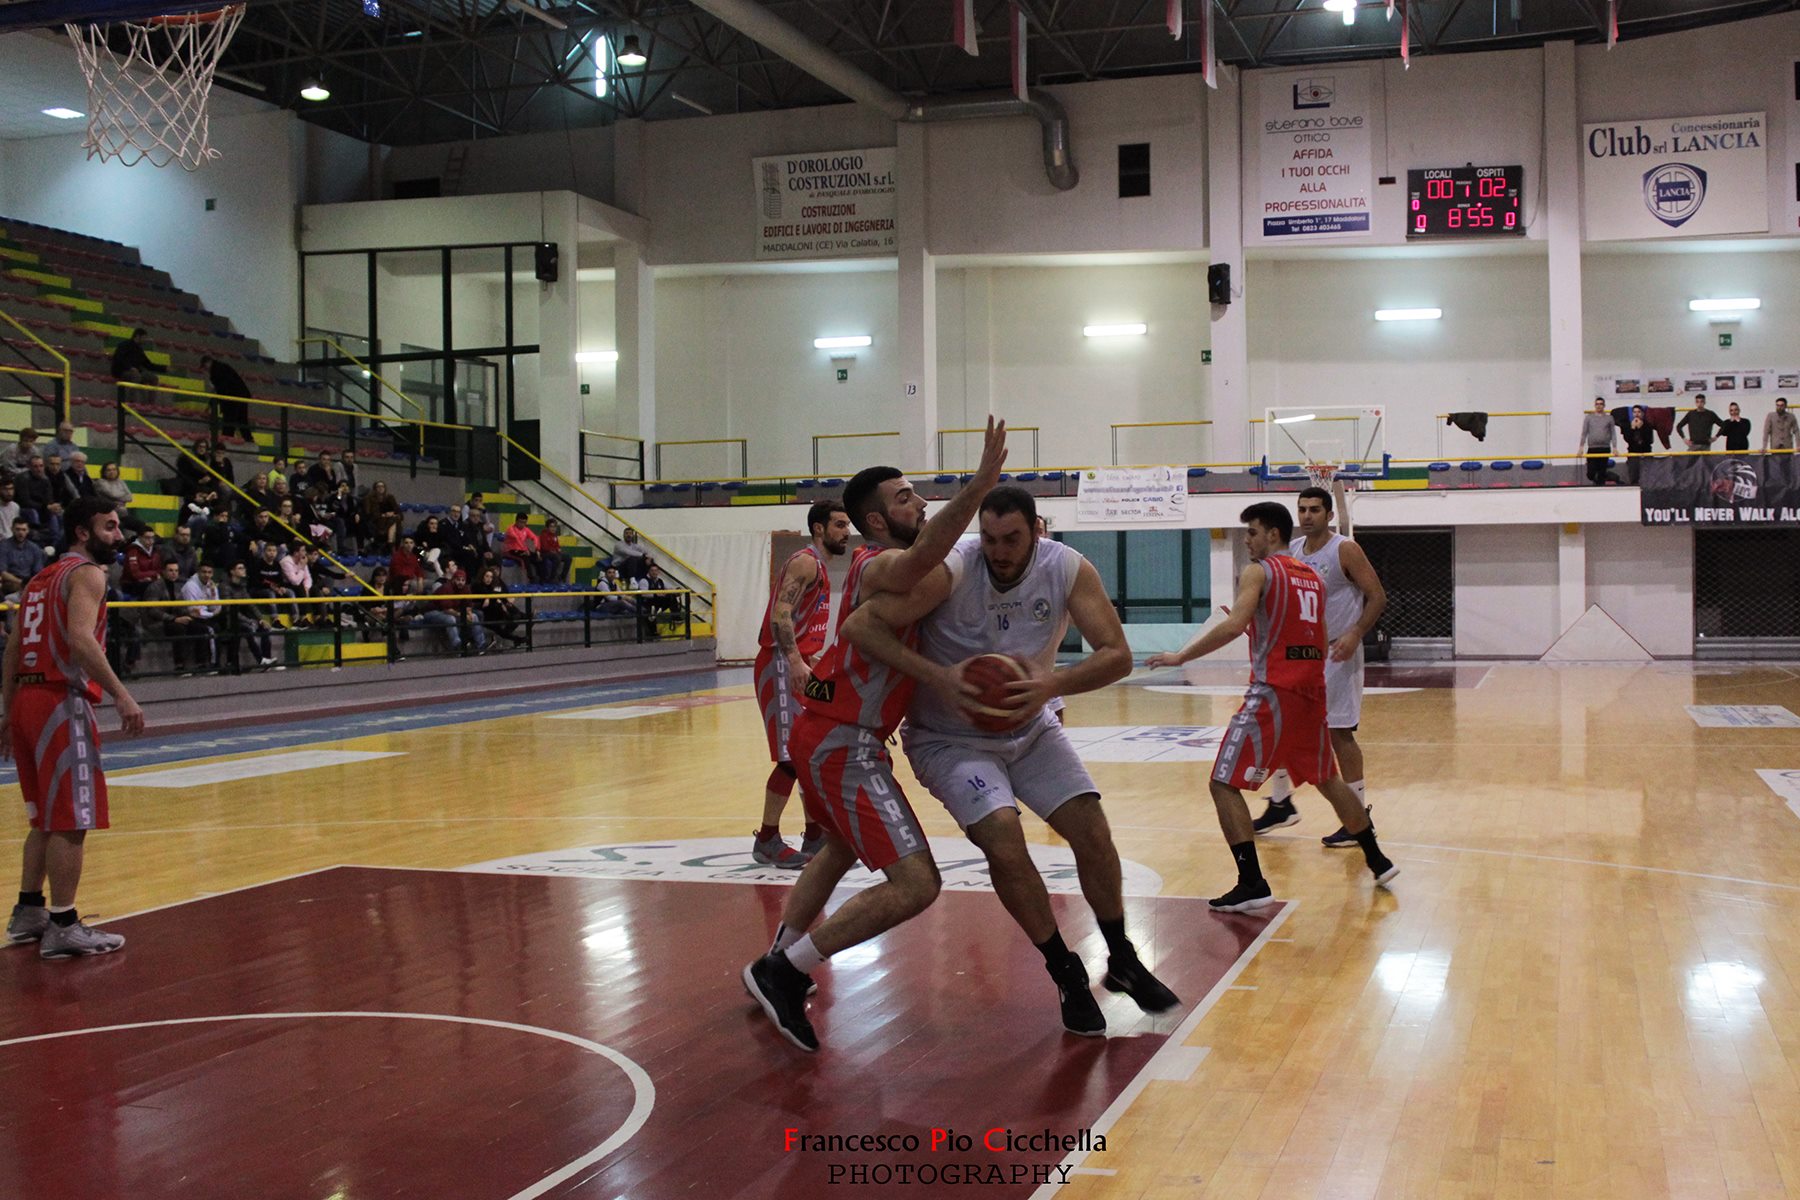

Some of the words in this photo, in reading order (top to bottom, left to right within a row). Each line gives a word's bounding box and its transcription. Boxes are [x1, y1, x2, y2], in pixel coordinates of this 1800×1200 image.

[1671, 118, 1760, 134] Concessionaria
[1589, 126, 1651, 158] Club
[1653, 141, 1668, 154] srl
[1671, 131, 1761, 153] LANCIA
[1293, 149, 1333, 160] AFFIDA
[787, 156, 863, 175] D'OROLOGIO
[1282, 168, 1285, 178] I
[1288, 166, 1314, 177] TUOI
[1317, 165, 1350, 176] OCCHI
[1476, 168, 1504, 178] OSPITI
[788, 173, 871, 191] COSTRUZIONI
[1424, 170, 1452, 179] LOCALI
[1299, 182, 1327, 193] ALLA
[1427, 179, 1454, 199] 00
[1465, 185, 1470, 198] 1
[1479, 178, 1507, 198] 02
[1659, 187, 1690, 198] LANCIA
[801, 203, 856, 218] COSTRUZIONI
[1411, 199, 1421, 211] 0
[1416, 214, 1427, 228] 0
[1505, 212, 1516, 226] 0
[764, 226, 794, 238] EDIFICI
[796, 224, 801, 236] E
[802, 222, 831, 236] LAVORI
[833, 221, 843, 233] DI
[844, 219, 895, 233] INGEGNERIA
[763, 241, 813, 252] MADDALONI
[815, 240, 834, 251] (CE)
[835, 239, 849, 248] Via
[884, 237, 894, 246] 16
[907, 384, 916, 395] 13
[1645, 507, 1690, 522] YOU'LL
[1694, 507, 1735, 521] NEVER
[1739, 506, 1775, 521] WALK
[1296, 588, 1318, 624] 10
[997, 614, 1009, 631] 16
[967, 775, 986, 790] 16
